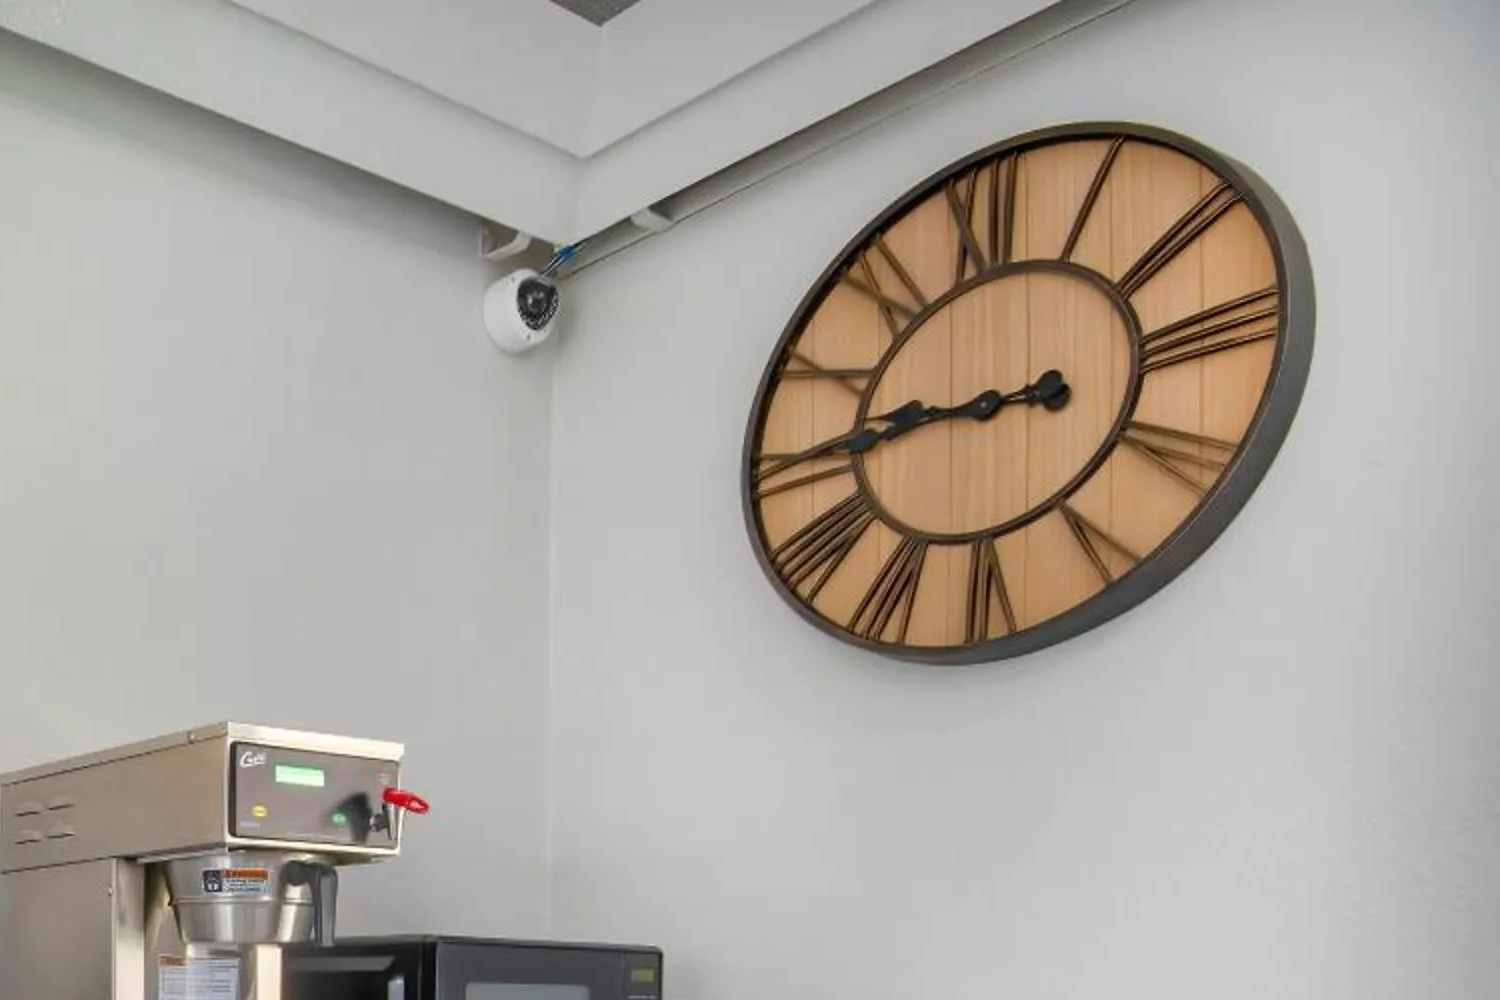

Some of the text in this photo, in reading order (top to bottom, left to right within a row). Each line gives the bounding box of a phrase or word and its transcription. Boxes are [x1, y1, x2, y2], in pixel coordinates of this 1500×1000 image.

[944, 154, 1018, 283] XII
[1114, 179, 1245, 301] II
[840, 236, 927, 335] XI
[1140, 284, 1280, 375] III
[781, 351, 876, 397] X
[771, 492, 878, 606] VIII
[850, 536, 928, 645] VII
[964, 538, 1017, 645] VI
[1058, 499, 1142, 582] V
